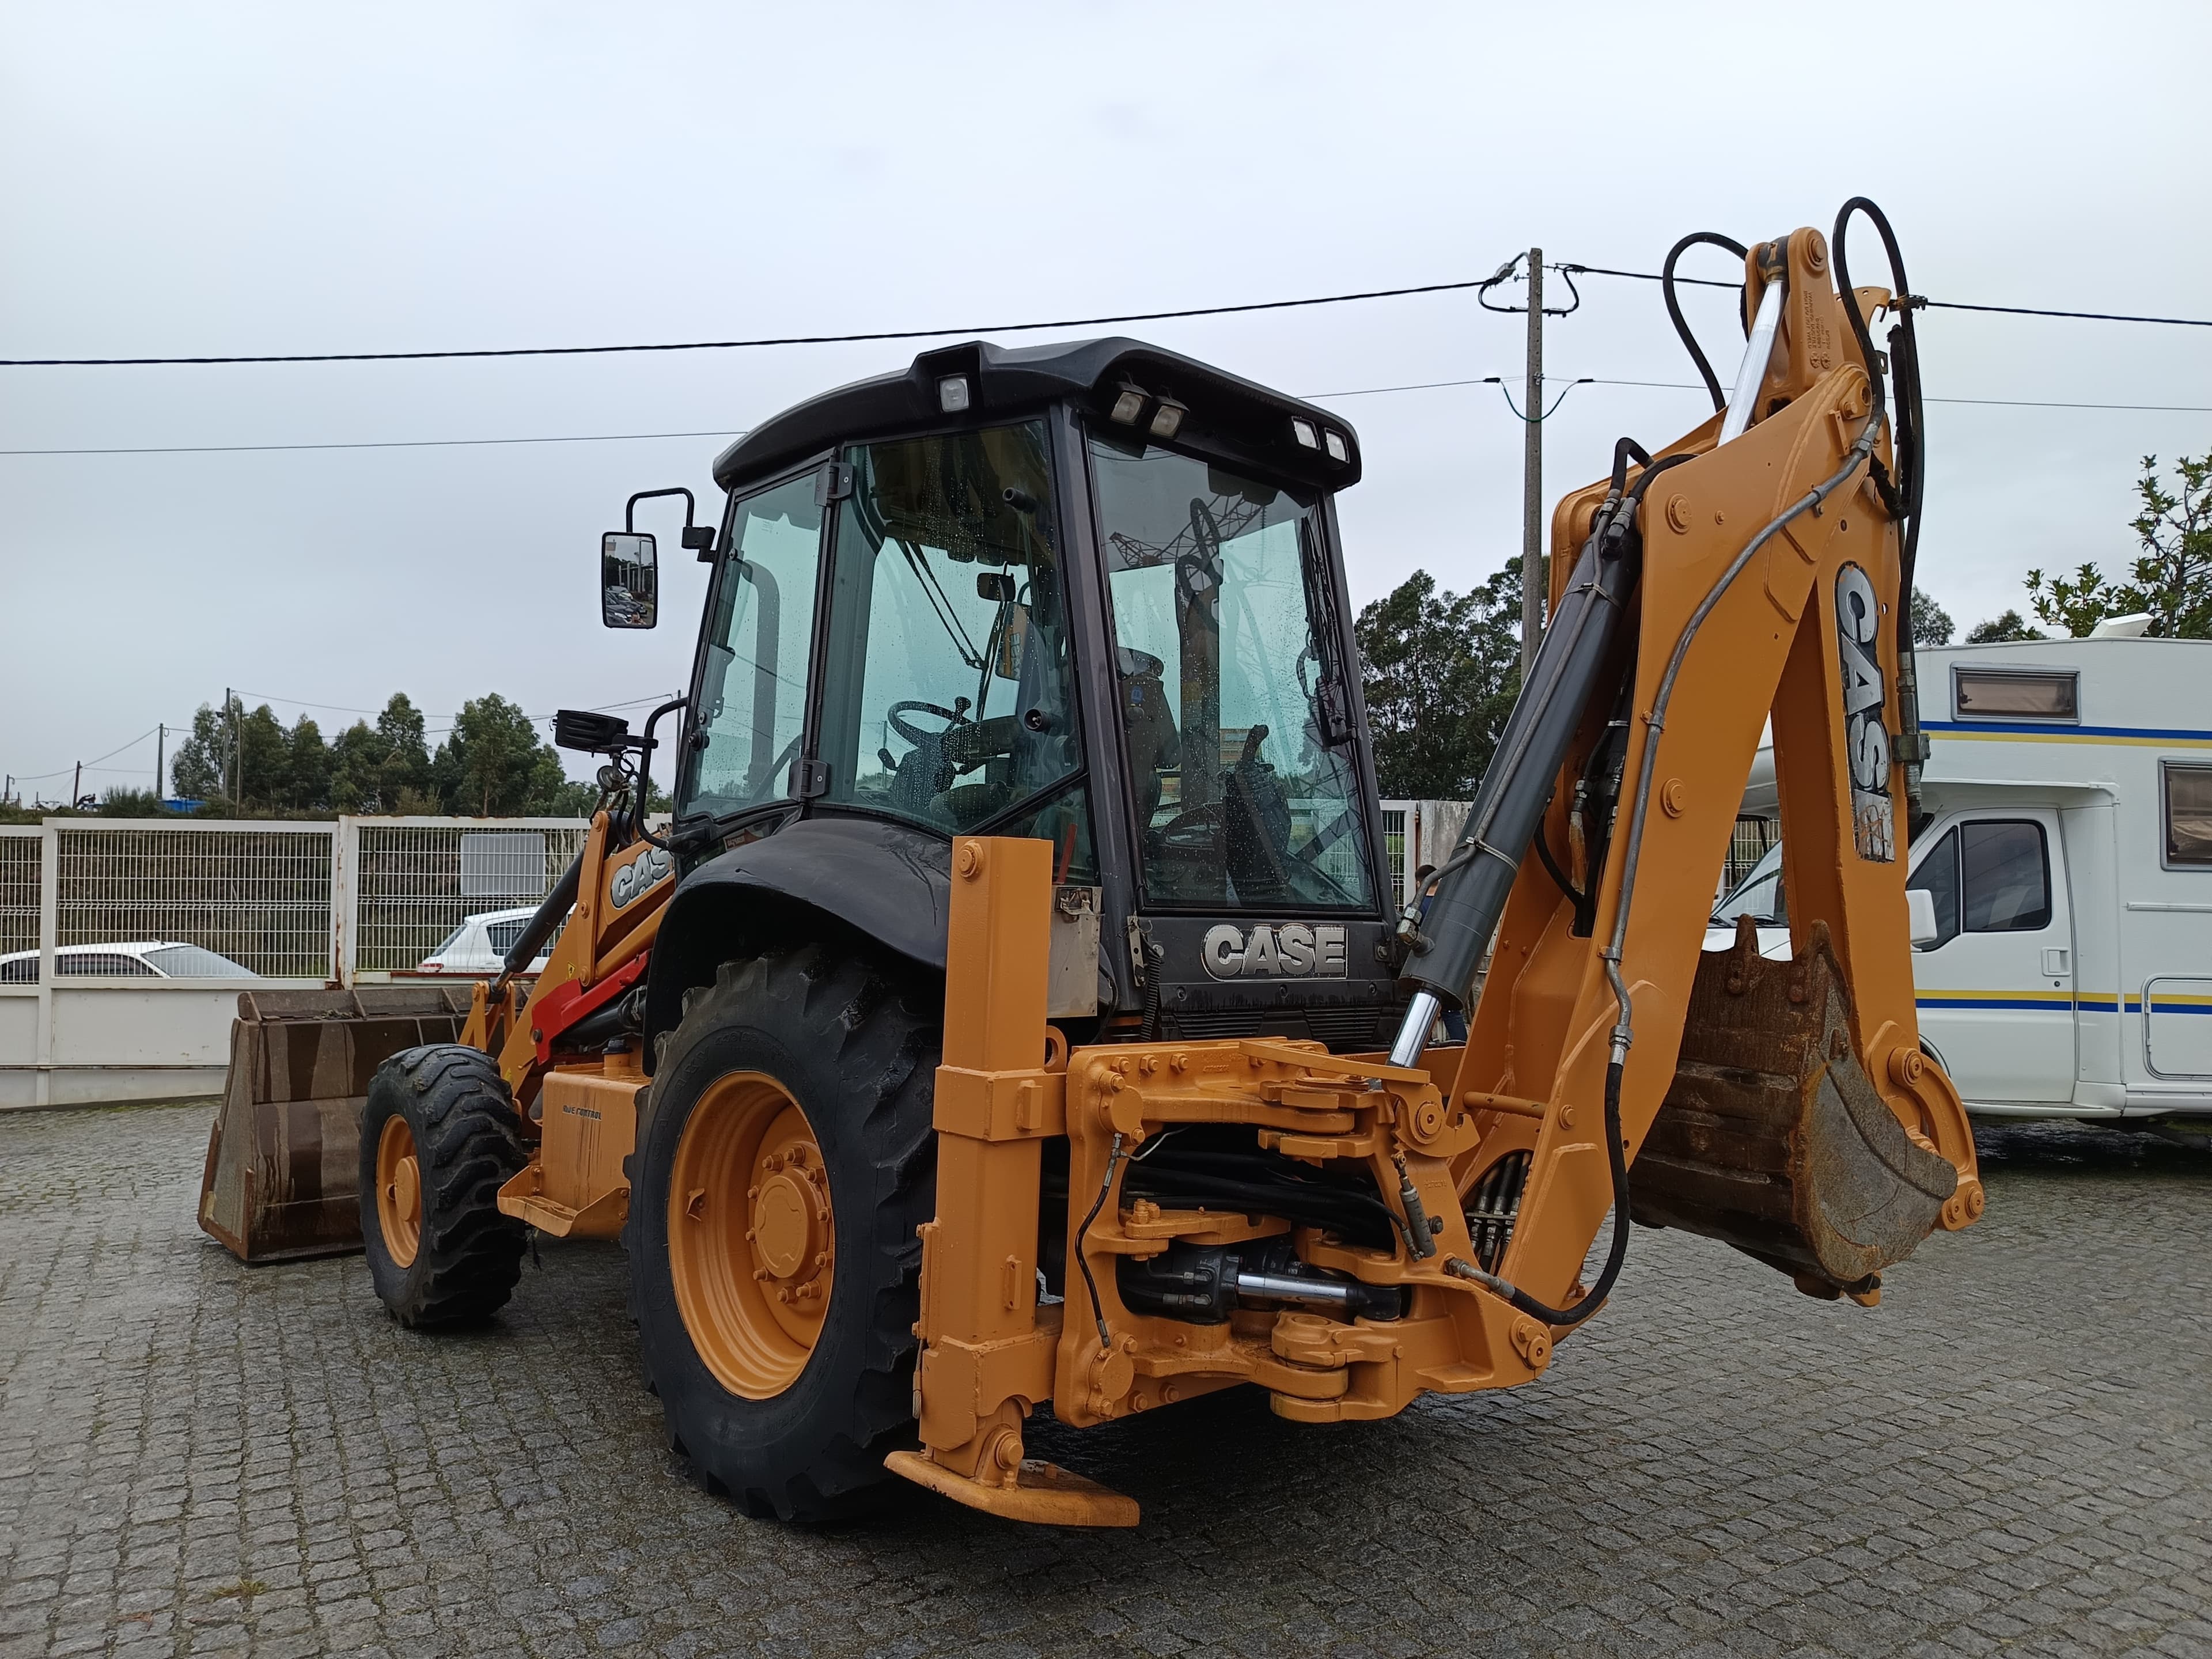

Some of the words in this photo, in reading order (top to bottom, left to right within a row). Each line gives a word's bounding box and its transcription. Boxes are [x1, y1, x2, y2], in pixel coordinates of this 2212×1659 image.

[1835, 562, 1895, 862] CASE
[611, 846, 674, 908] CAS
[1202, 924, 1347, 978] CASE
